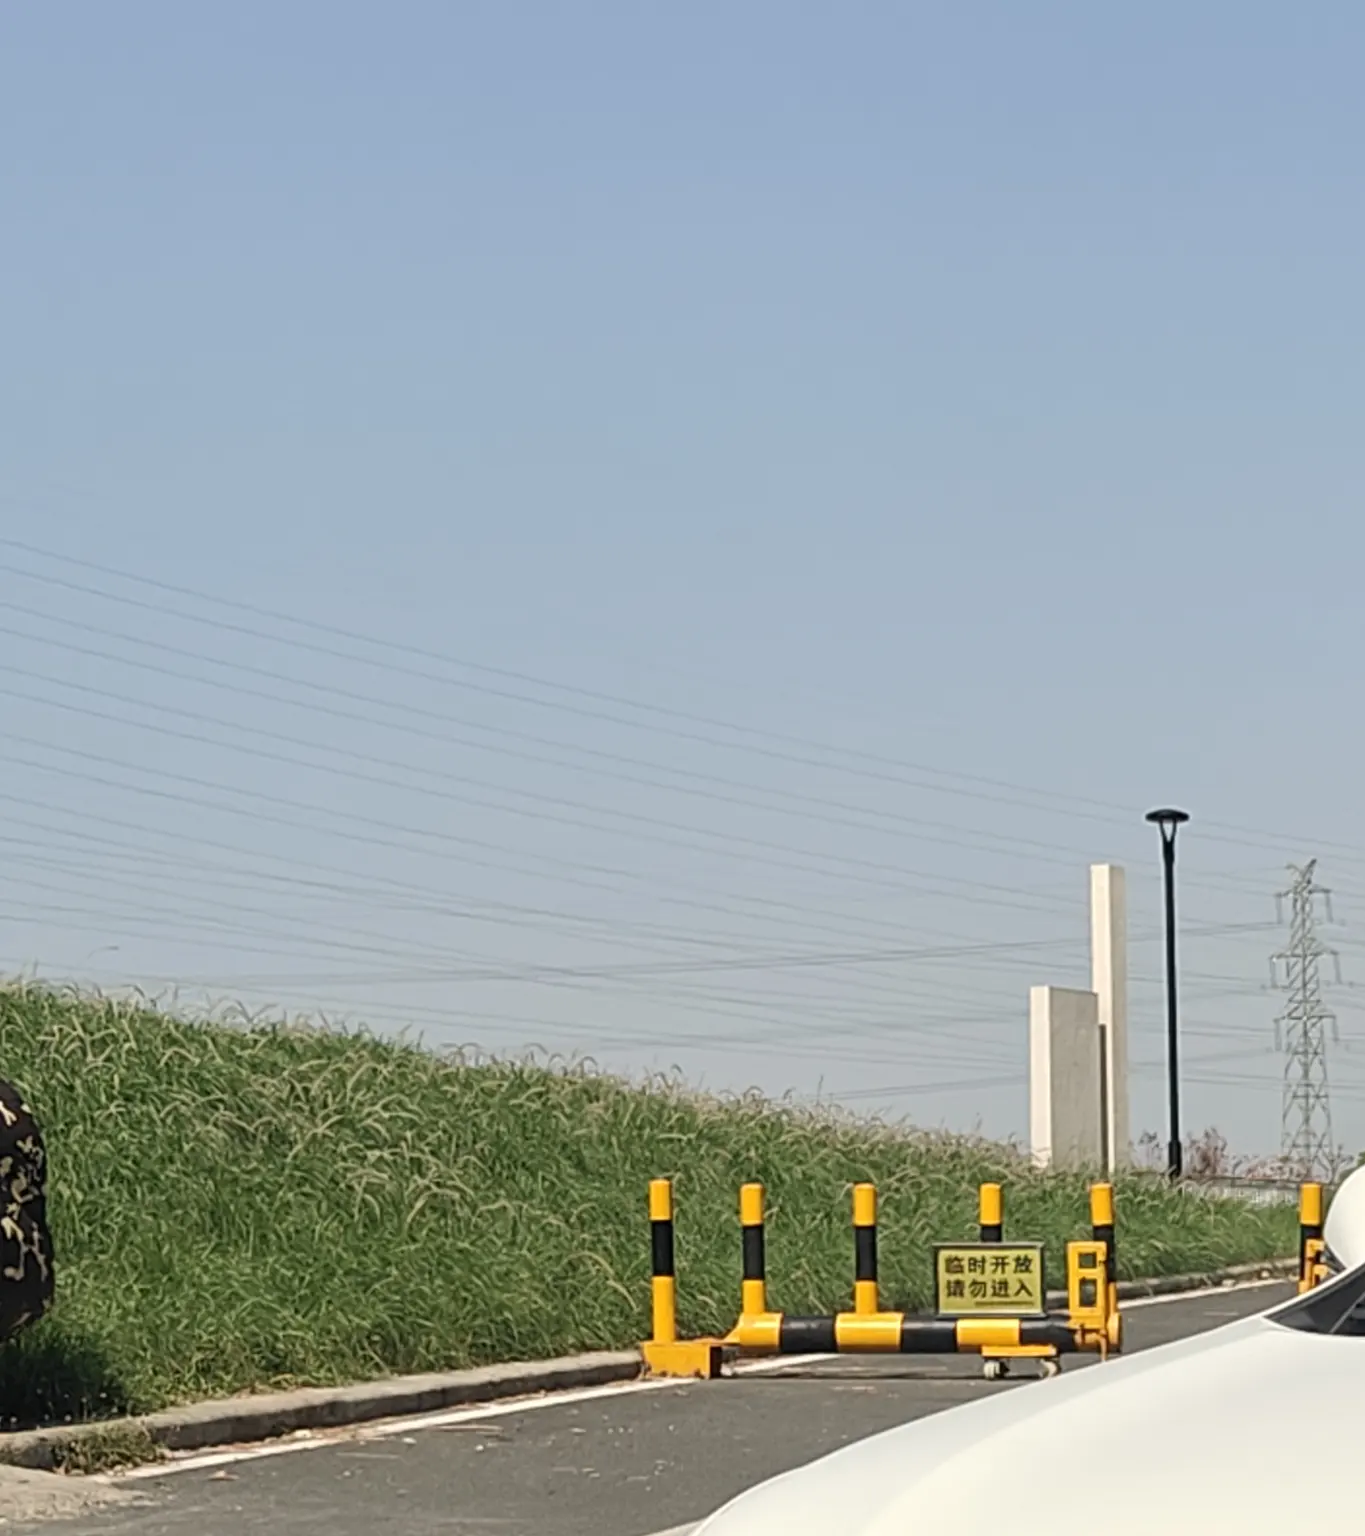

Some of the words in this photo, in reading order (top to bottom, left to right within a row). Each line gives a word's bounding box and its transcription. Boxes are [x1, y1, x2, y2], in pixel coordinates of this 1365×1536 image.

[944, 1255, 1033, 1274] 临时开放
[946, 1279, 1033, 1298] 请勿进入
